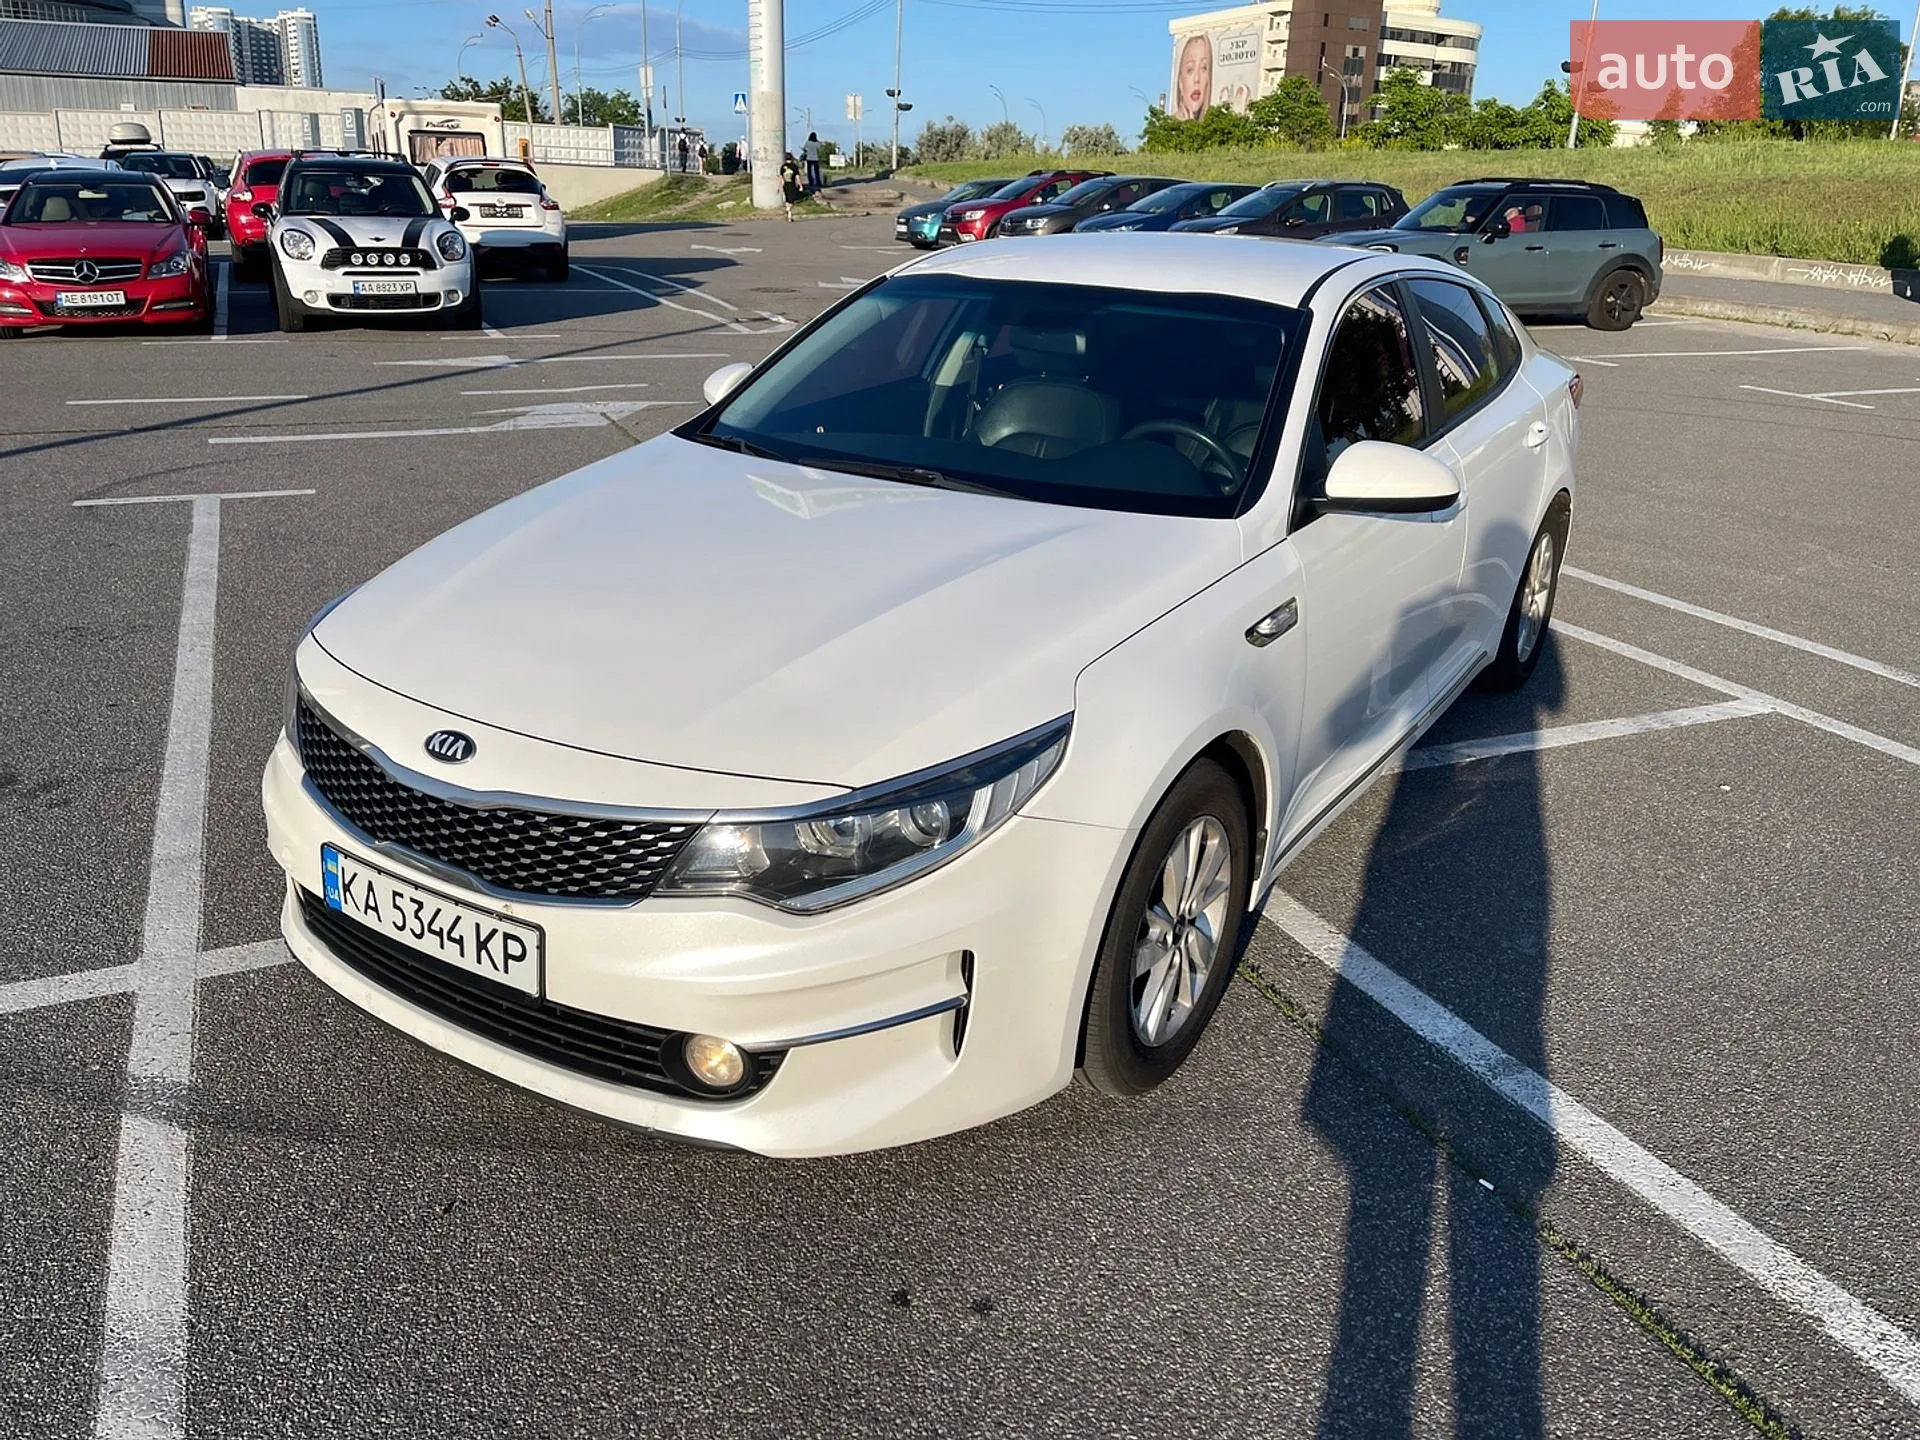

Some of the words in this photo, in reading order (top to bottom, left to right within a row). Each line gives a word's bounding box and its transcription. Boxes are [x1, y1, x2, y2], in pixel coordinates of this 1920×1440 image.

[1230, 40, 1248, 50] УКР
[1220, 50, 1256, 62] ЗОЛОТО
[361, 283, 375, 293] AA
[399, 282, 412, 292] XP
[64, 294, 78, 304] AE
[106, 293, 121, 303] OT
[428, 733, 466, 760] KIA
[341, 866, 382, 923] KA
[391, 889, 465, 959] 5344
[475, 922, 528, 975] KP
